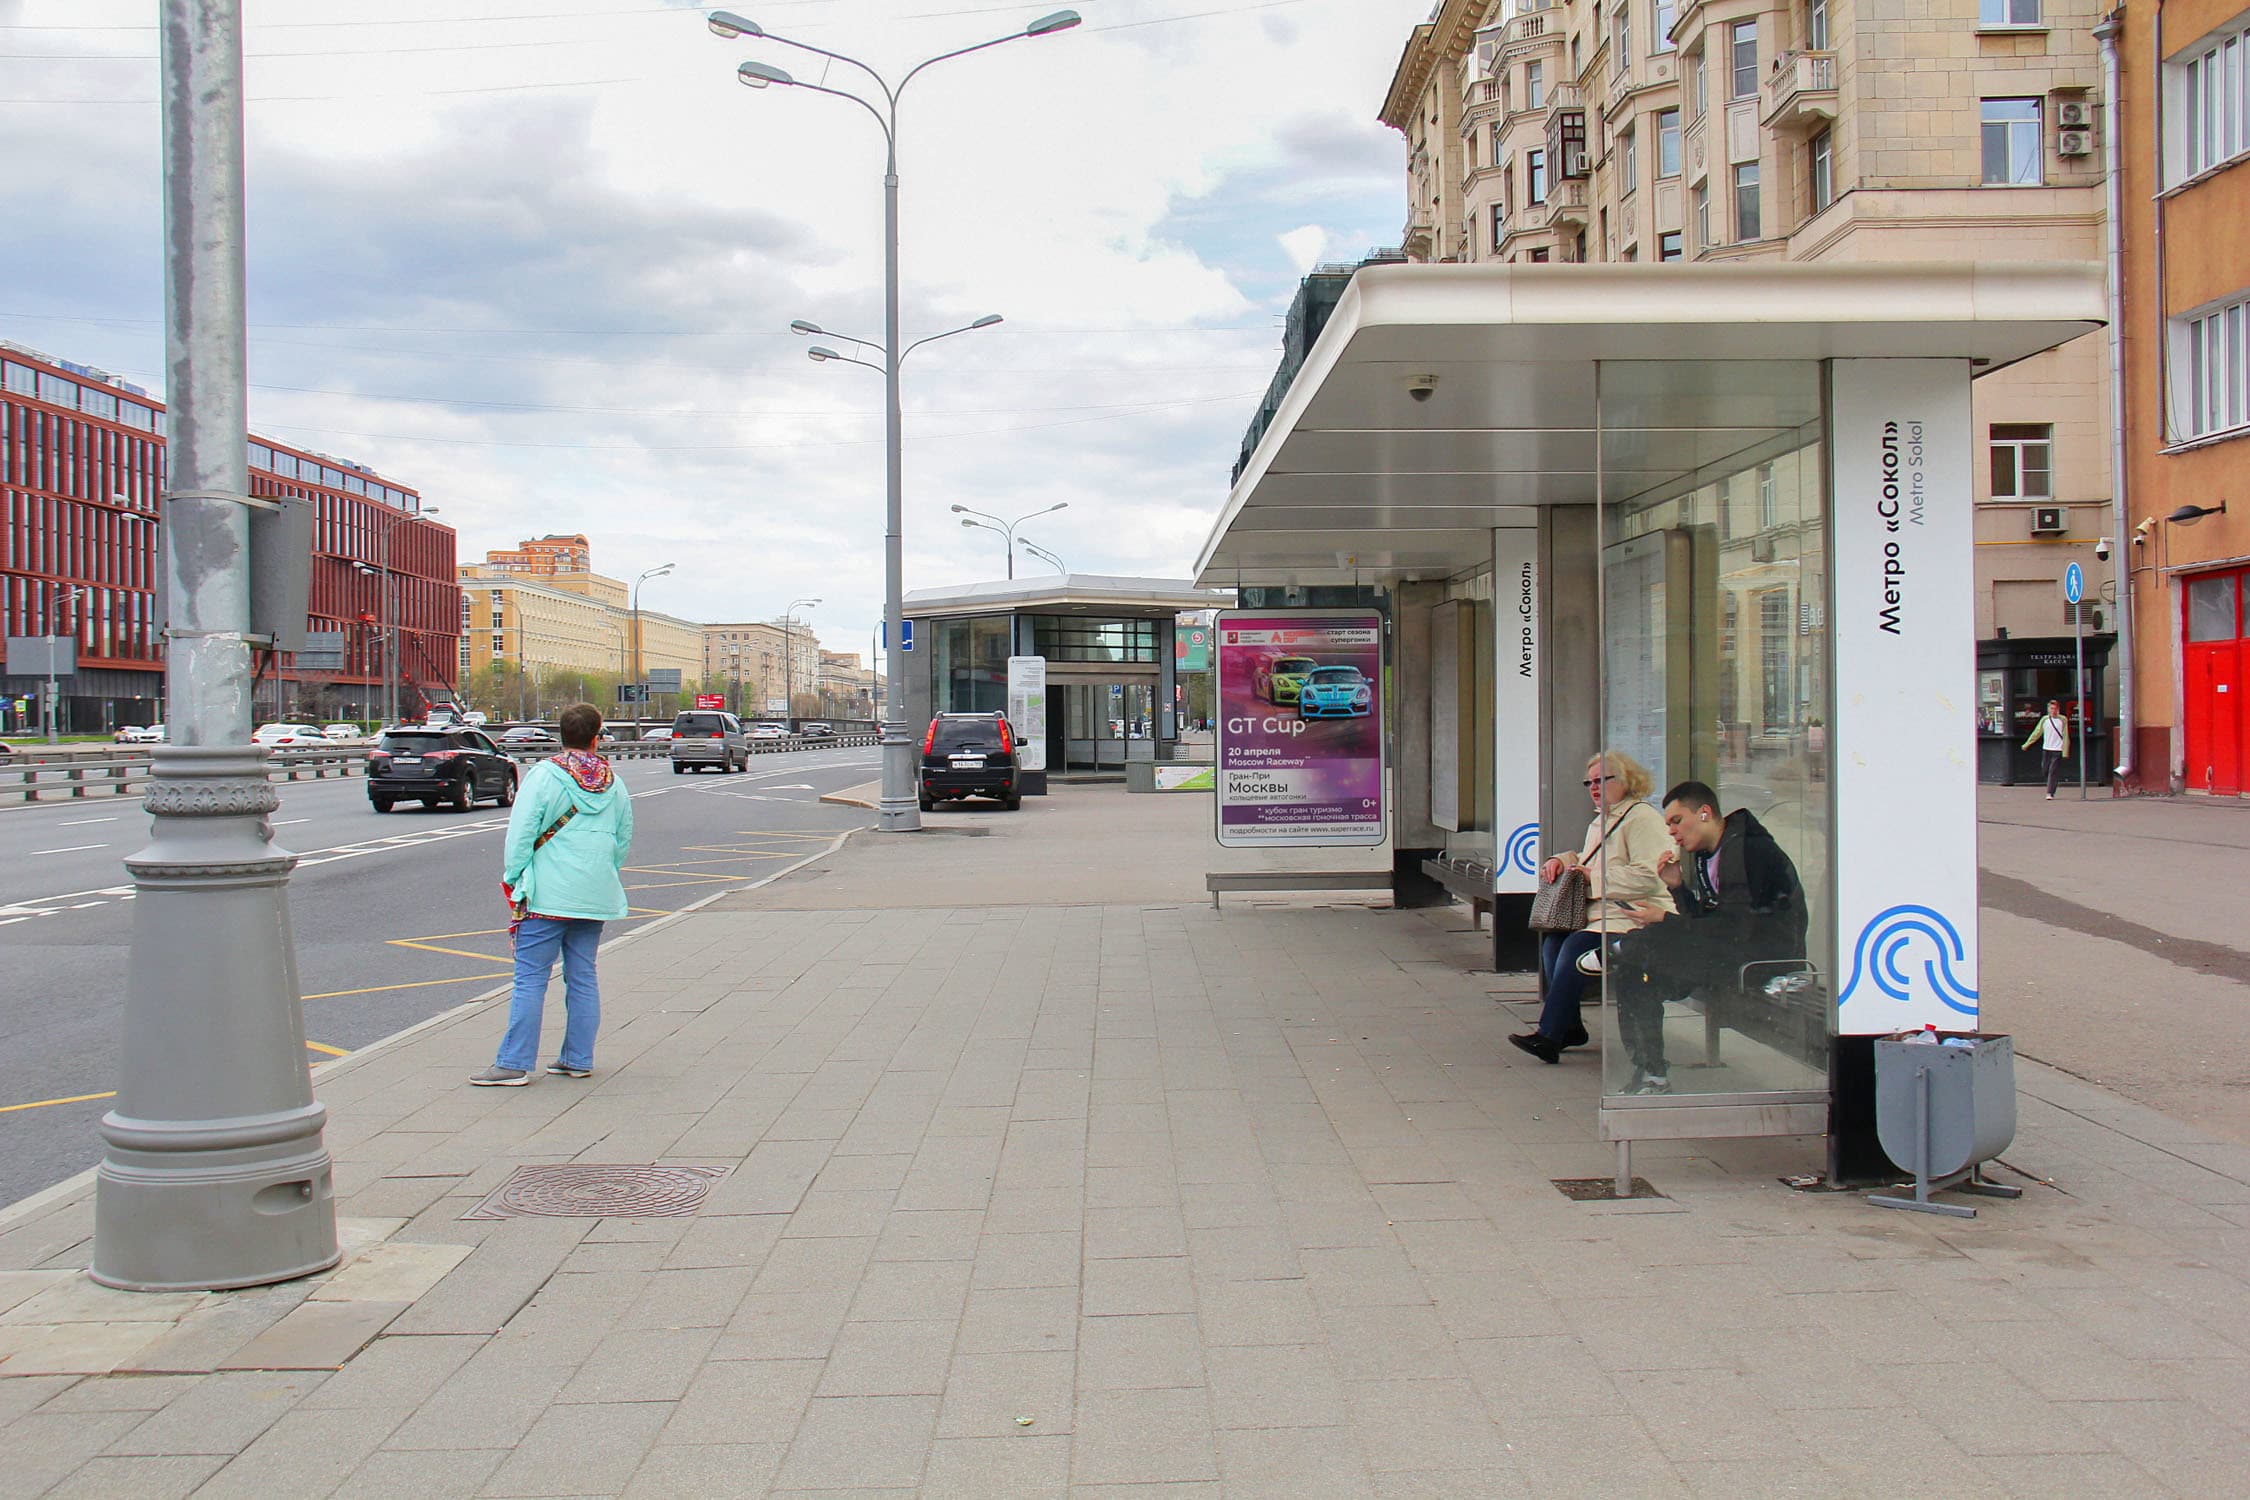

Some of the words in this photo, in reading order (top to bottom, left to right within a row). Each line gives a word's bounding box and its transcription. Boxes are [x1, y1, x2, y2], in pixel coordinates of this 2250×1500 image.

[1907, 421, 1923, 466] Sokol
[1878, 421, 1899, 532] «Сокол»
[1909, 471, 1924, 525] Metro
[1519, 562, 1532, 622] «Сокол»
[1880, 542, 1905, 634] Метро
[1520, 627, 1534, 677] Метро
[1228, 718, 1257, 734] GT
[1228, 747, 1242, 756] 20
[1243, 748, 1281, 756] апреля
[1228, 758, 1264, 766] Moscow
[1229, 782, 1288, 793] Москвы
[1362, 799, 1377, 808] 0+
